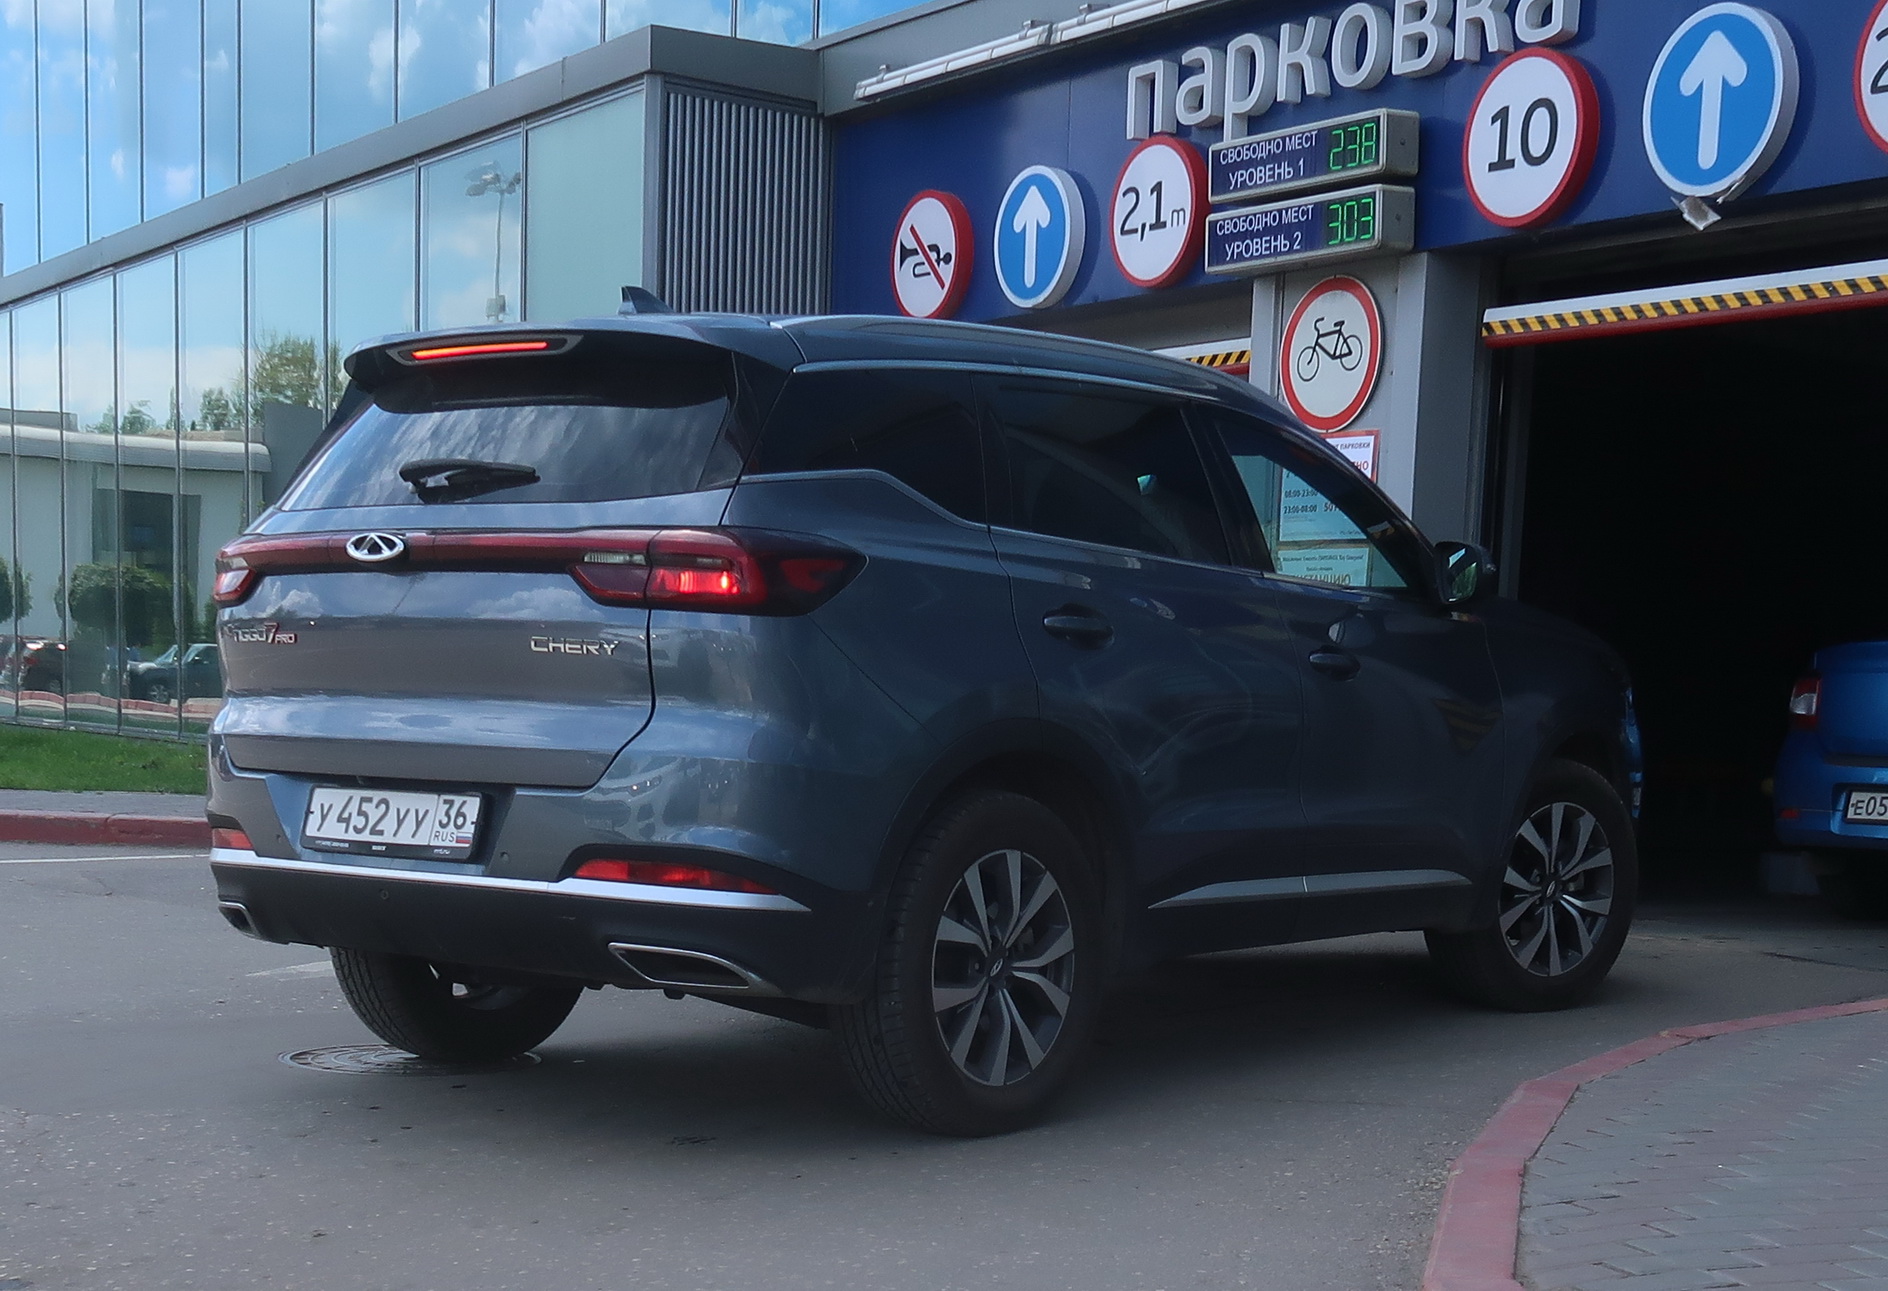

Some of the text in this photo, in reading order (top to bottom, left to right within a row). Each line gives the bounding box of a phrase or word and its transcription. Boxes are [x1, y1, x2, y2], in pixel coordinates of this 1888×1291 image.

[1219, 130, 1318, 165] СВОБОДНО МЕСТ
[1329, 122, 1377, 170] 238
[1486, 97, 1559, 173] 10
[1229, 158, 1304, 190] УРОВЕНЬ 1
[1216, 204, 1315, 236] СВОБОДНО МЕСТ
[1328, 198, 1374, 245] 303
[1225, 231, 1302, 261] УРОВЕНЬ 2
[529, 636, 620, 656] CHERY
[438, 799, 468, 830] 36
[432, 831, 456, 842] RUS
